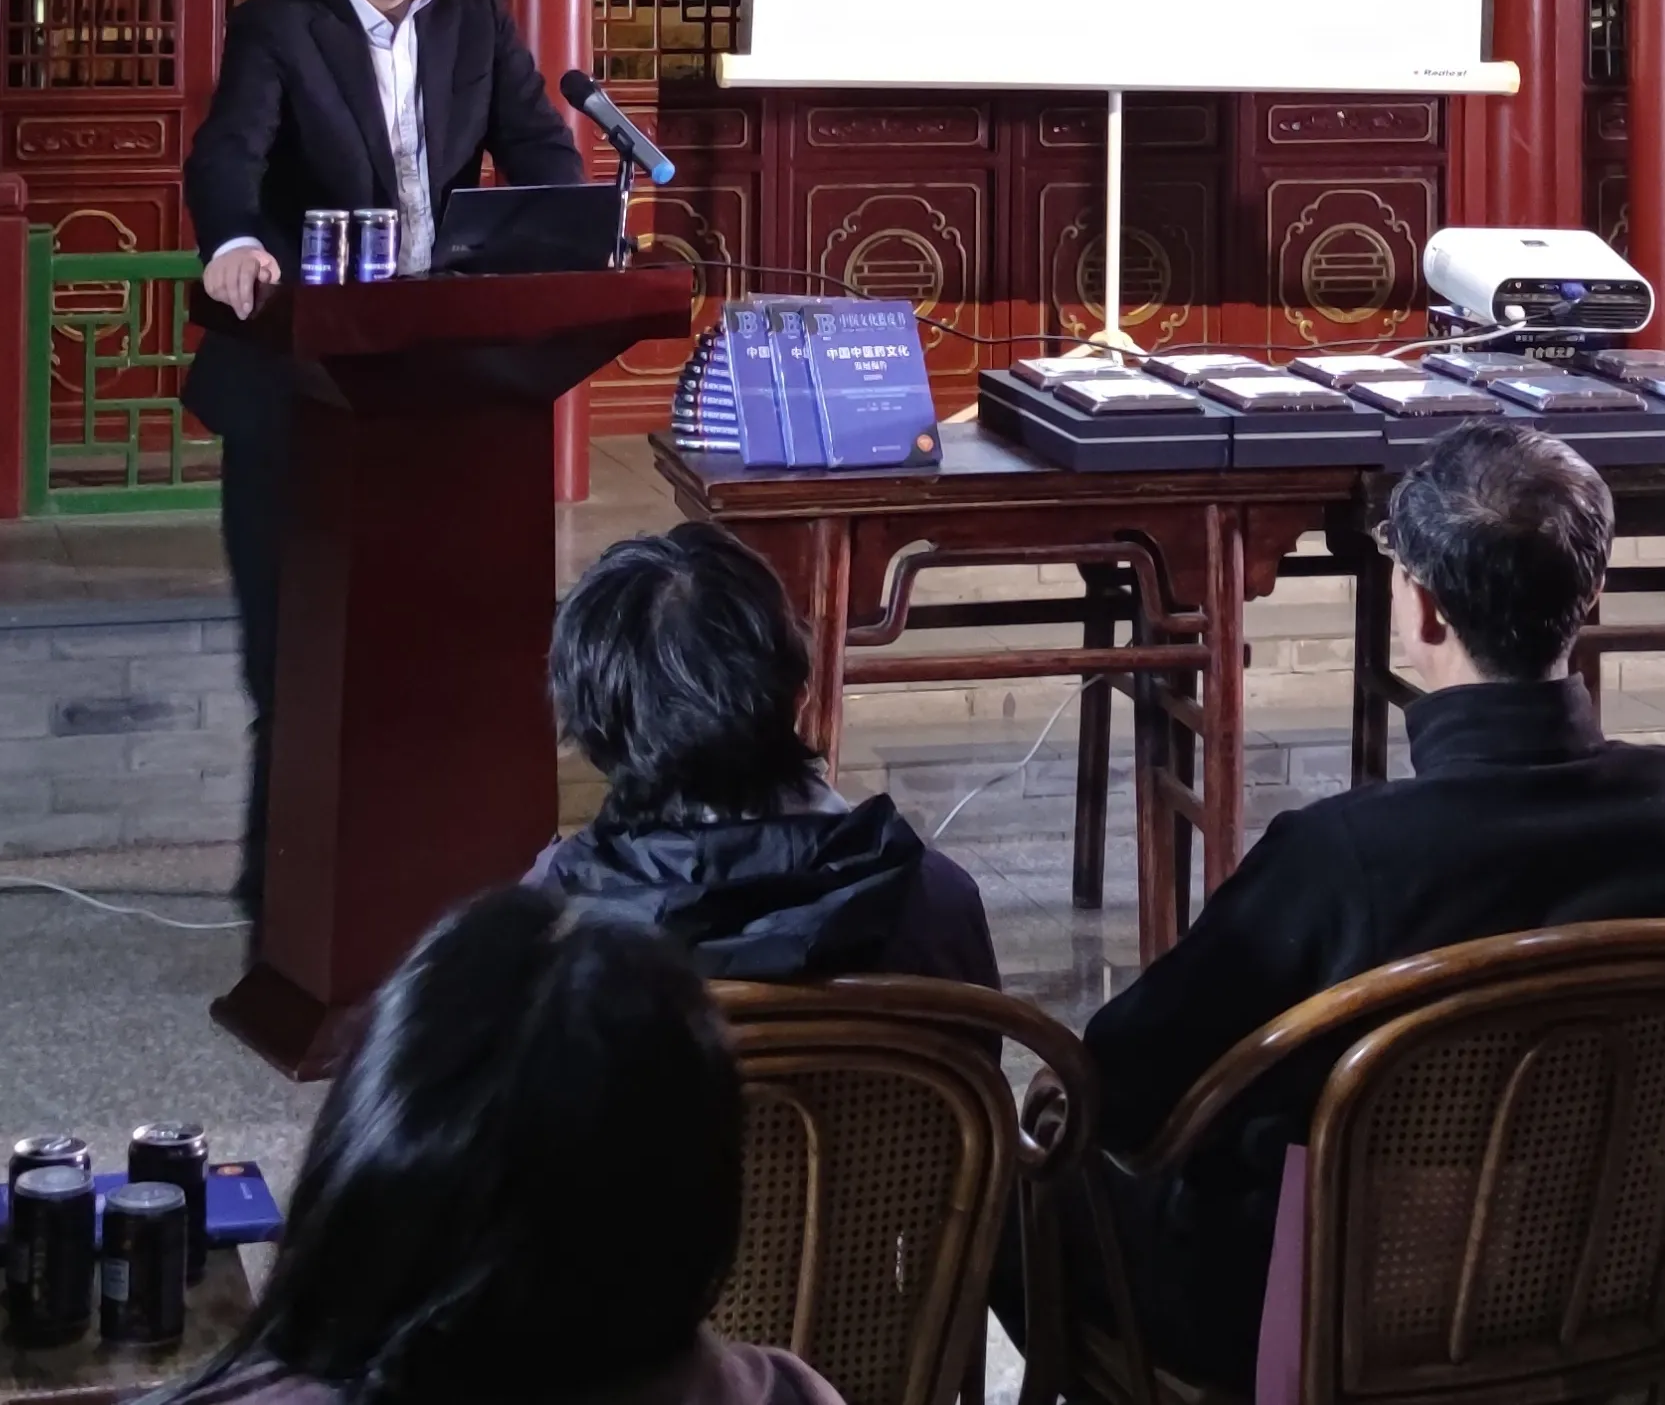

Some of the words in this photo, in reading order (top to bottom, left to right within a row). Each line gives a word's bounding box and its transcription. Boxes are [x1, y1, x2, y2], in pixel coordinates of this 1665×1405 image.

[826, 344, 910, 362] 中国中医药文化
